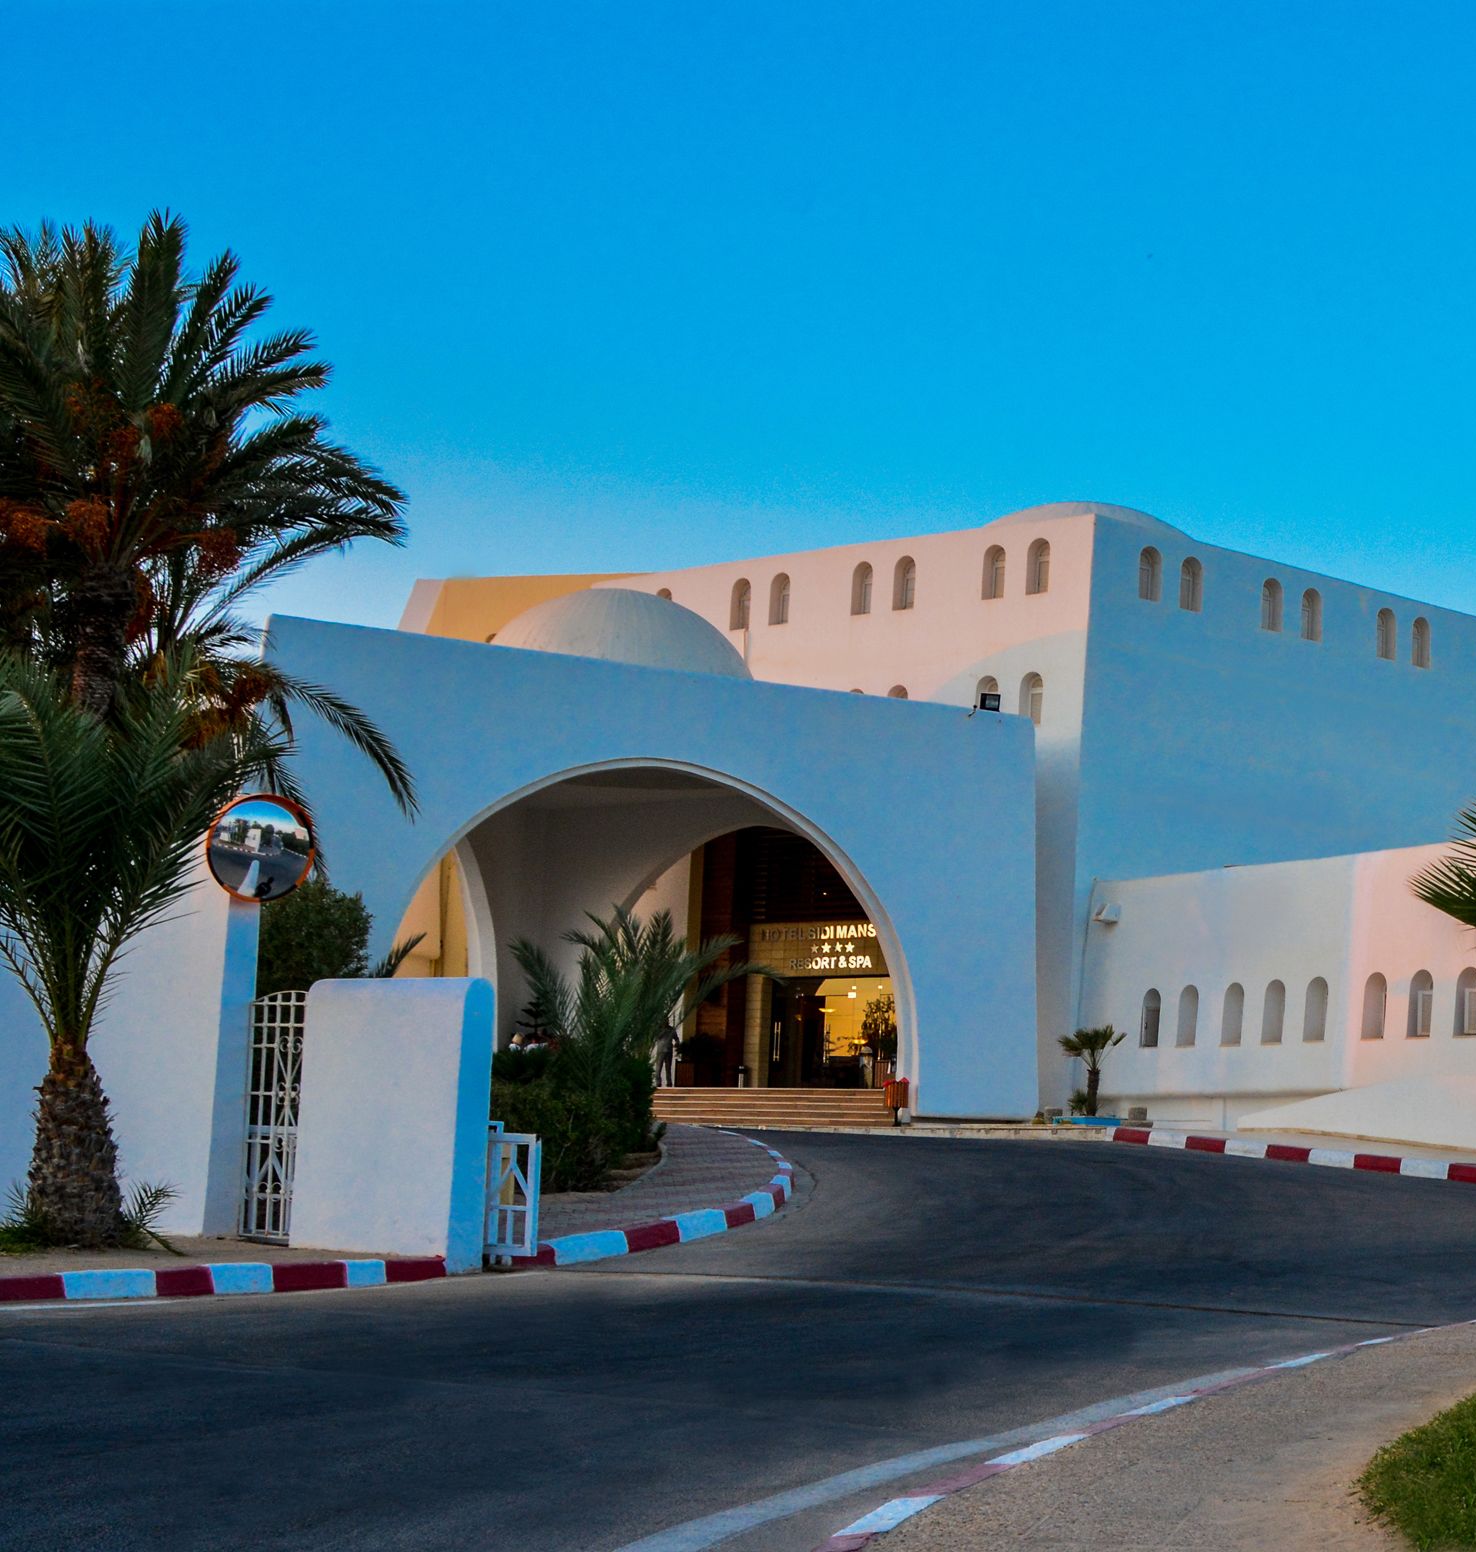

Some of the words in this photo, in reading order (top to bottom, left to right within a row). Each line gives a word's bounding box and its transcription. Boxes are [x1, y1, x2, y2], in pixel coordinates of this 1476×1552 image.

[761, 927, 804, 942] HOTEL
[808, 925, 835, 940] SIDI
[790, 956, 837, 970] RESORT
[838, 955, 847, 968] &
[848, 955, 872, 969] SPA
